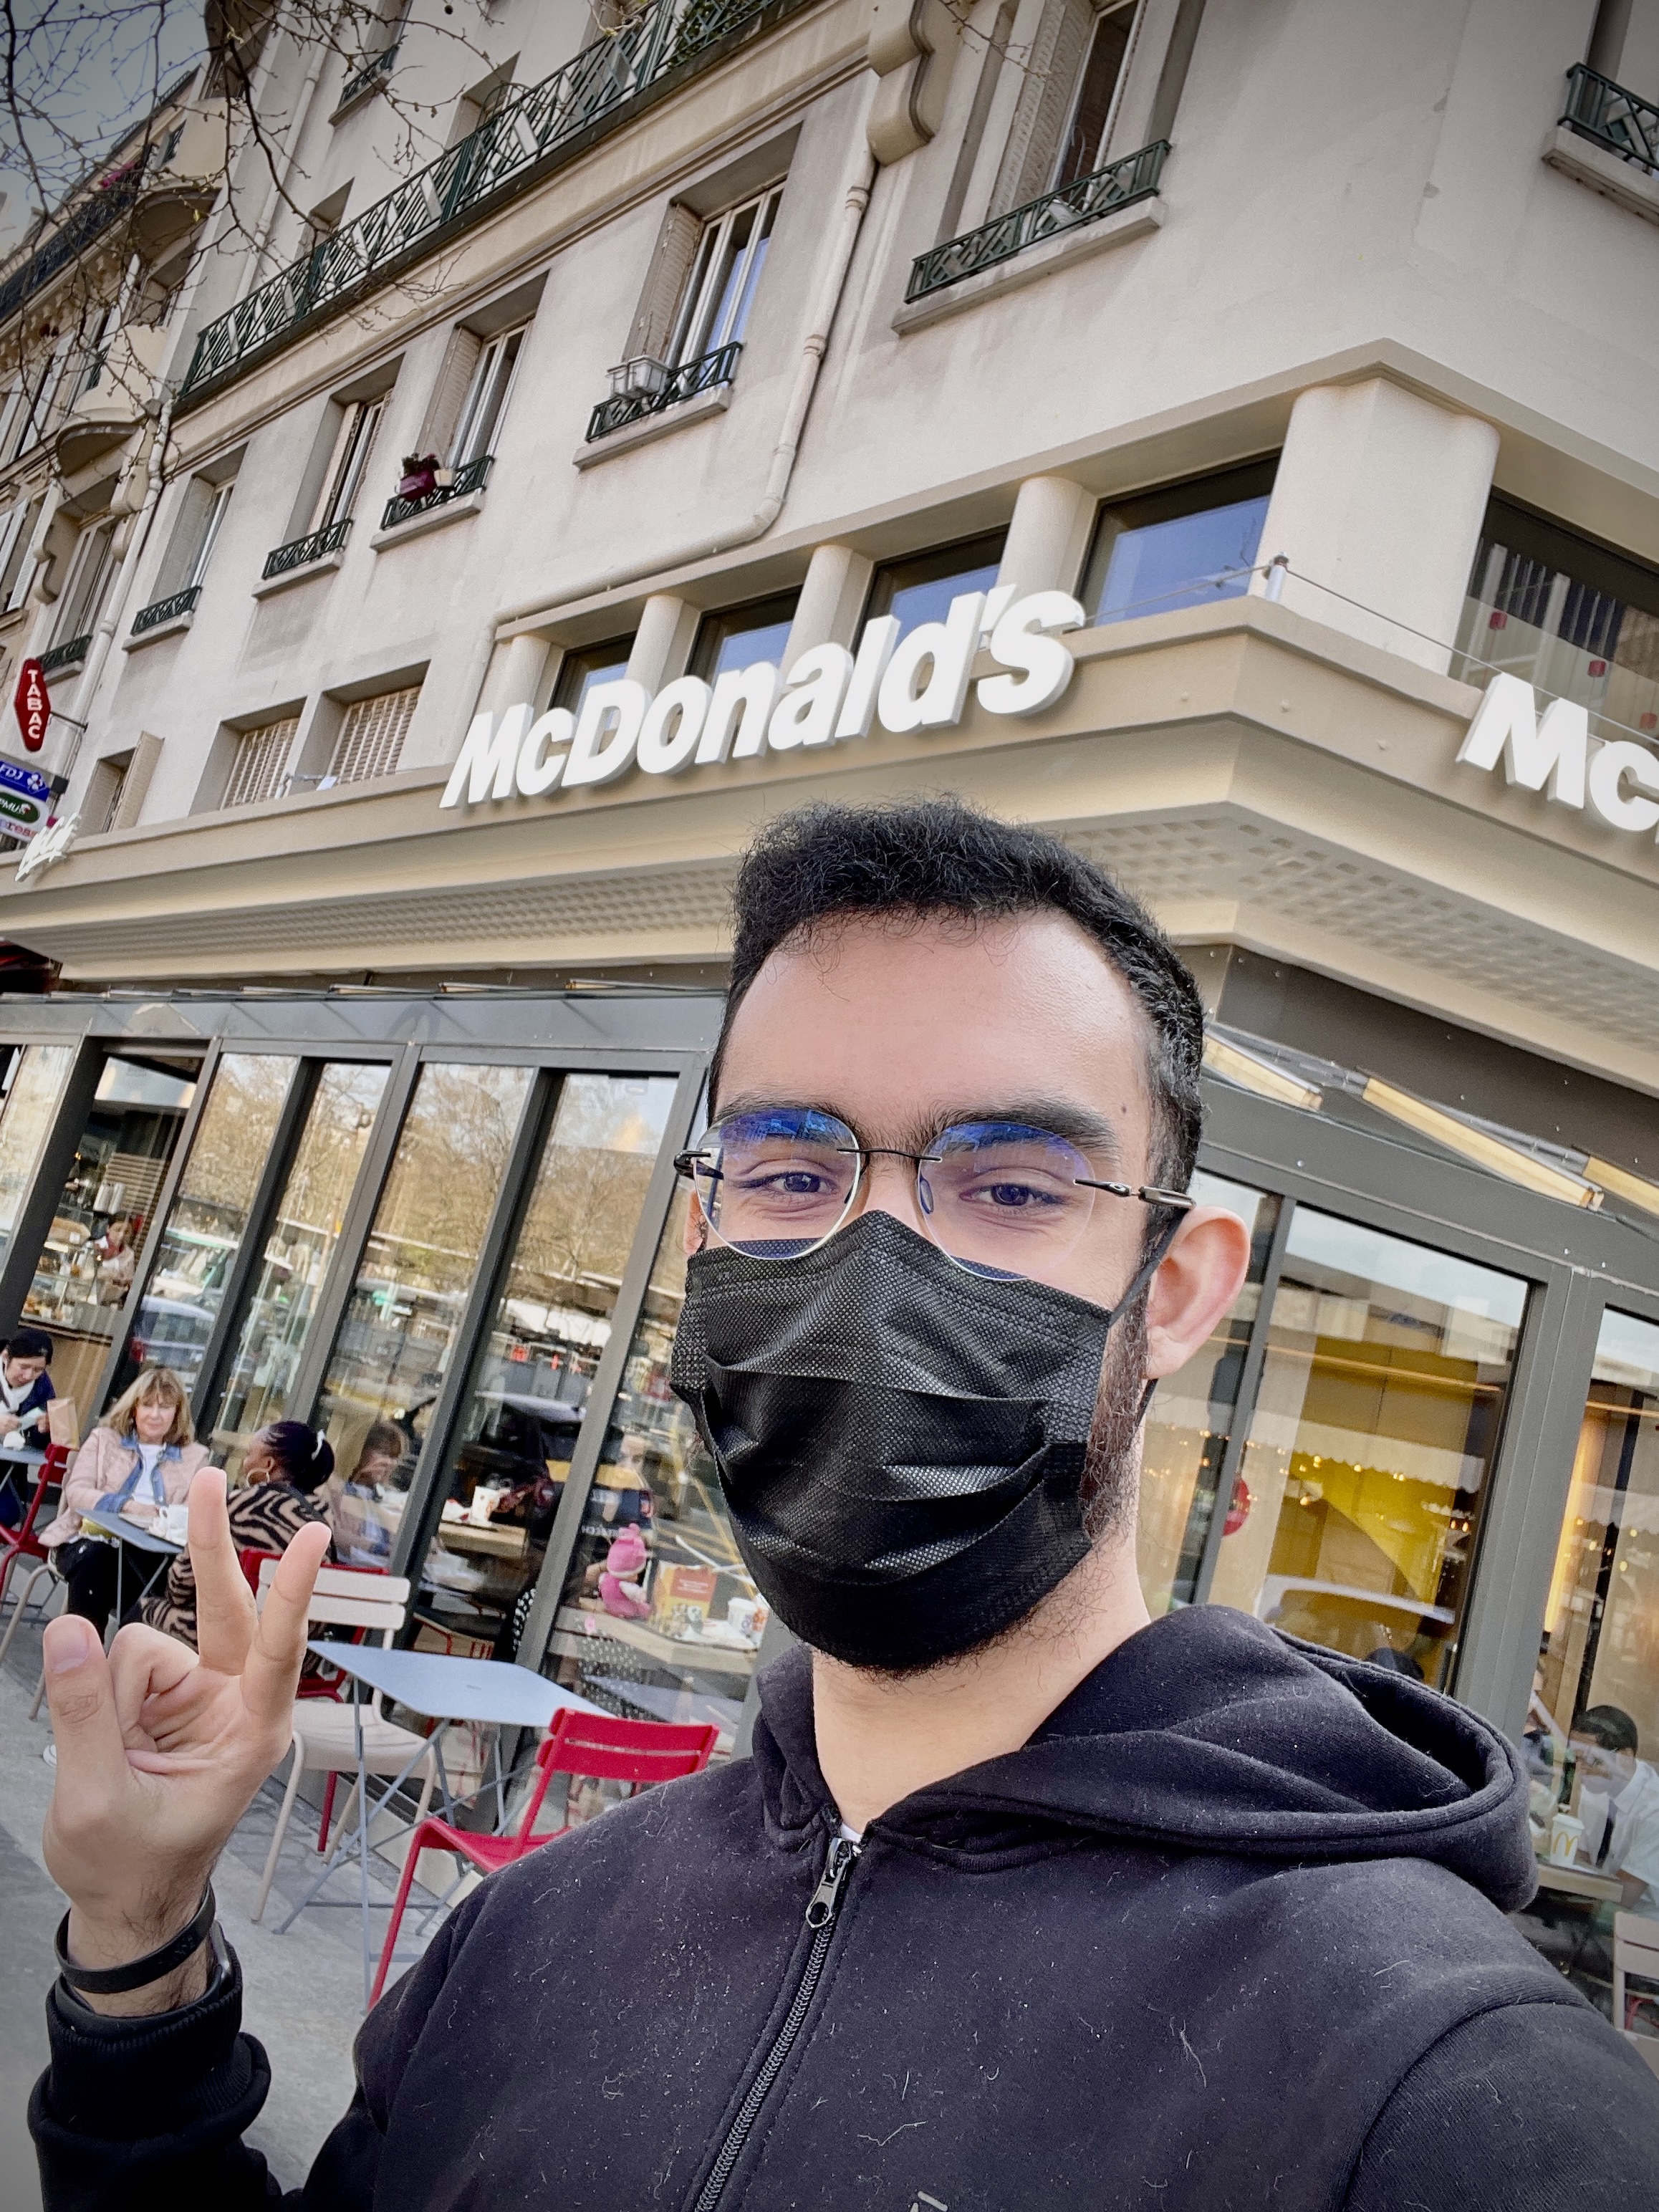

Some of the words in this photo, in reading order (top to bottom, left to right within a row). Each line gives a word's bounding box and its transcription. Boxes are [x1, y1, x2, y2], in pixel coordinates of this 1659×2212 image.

[27, 668, 43, 739] TABAC
[438, 583, 1087, 809] McDonald's
[1456, 671, 1659, 844] Mc
